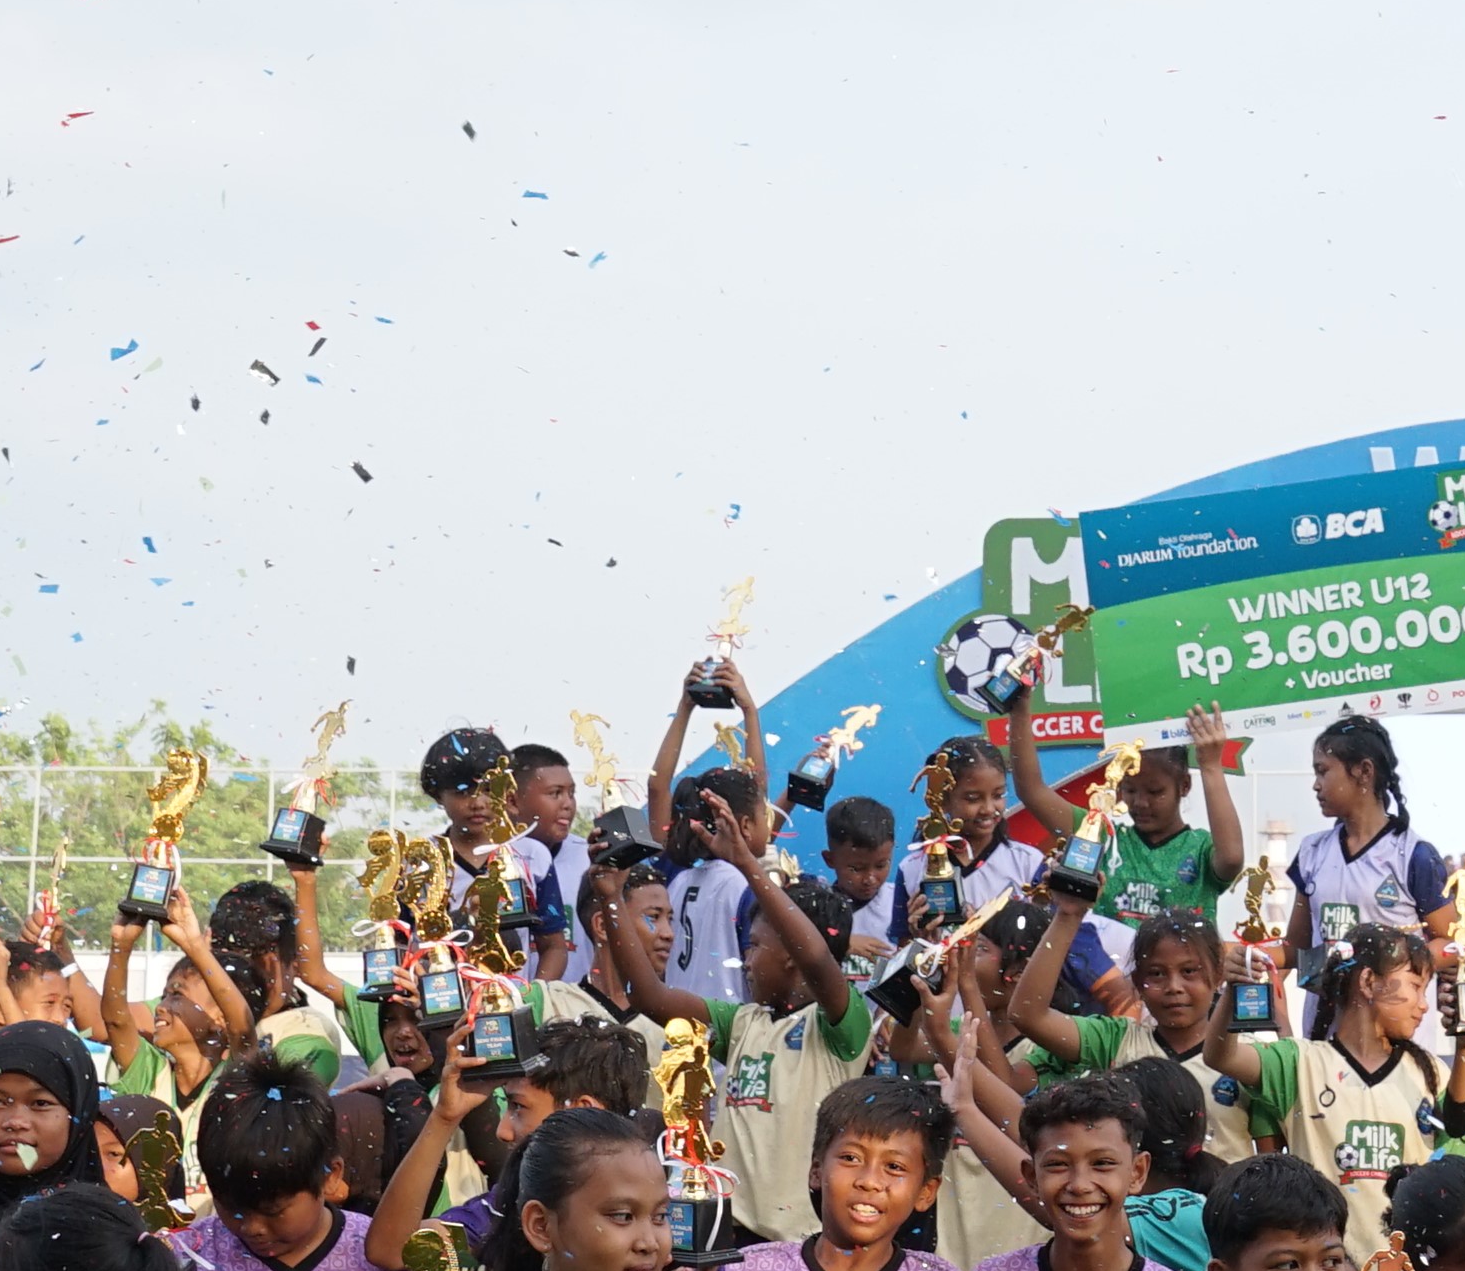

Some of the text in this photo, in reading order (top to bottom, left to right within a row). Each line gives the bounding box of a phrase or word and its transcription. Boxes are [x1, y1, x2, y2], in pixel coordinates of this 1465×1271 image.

[1325, 507, 1385, 539] BCA
[1118, 548, 1173, 567] DJARUM
[1228, 573, 1432, 623] WINNER U12
[1176, 642, 1233, 685] Rp
[1301, 662, 1393, 689] Voucher
[1005, 715, 1085, 741] CCER
[1127, 882, 1160, 901] Milk
[1131, 899, 1160, 916] Life
[1324, 906, 1357, 925] Milk
[677, 886, 700, 972] 5
[1327, 924, 1350, 940] Lif
[1352, 1125, 1399, 1150] Milk
[1360, 1148, 1400, 1170] Life
